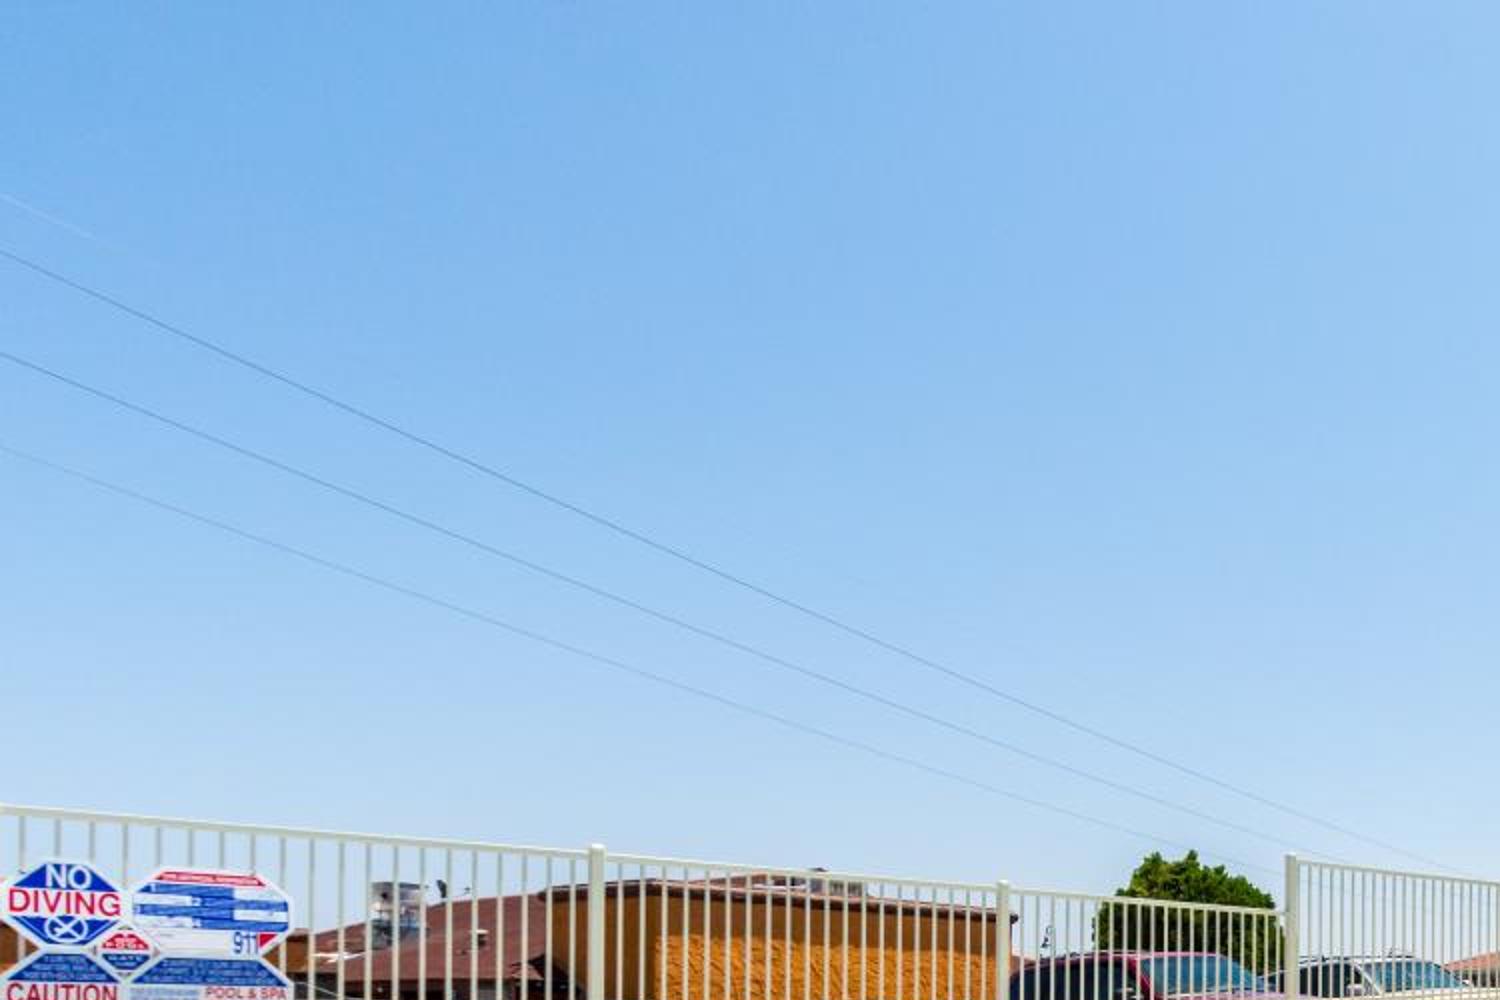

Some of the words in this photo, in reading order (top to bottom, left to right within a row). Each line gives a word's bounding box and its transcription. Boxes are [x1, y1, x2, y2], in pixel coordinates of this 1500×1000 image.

[45, 863, 92, 889] NO
[9, 888, 121, 916] DIVING
[206, 986, 244, 999] POOL
[260, 987, 287, 999] SPA
